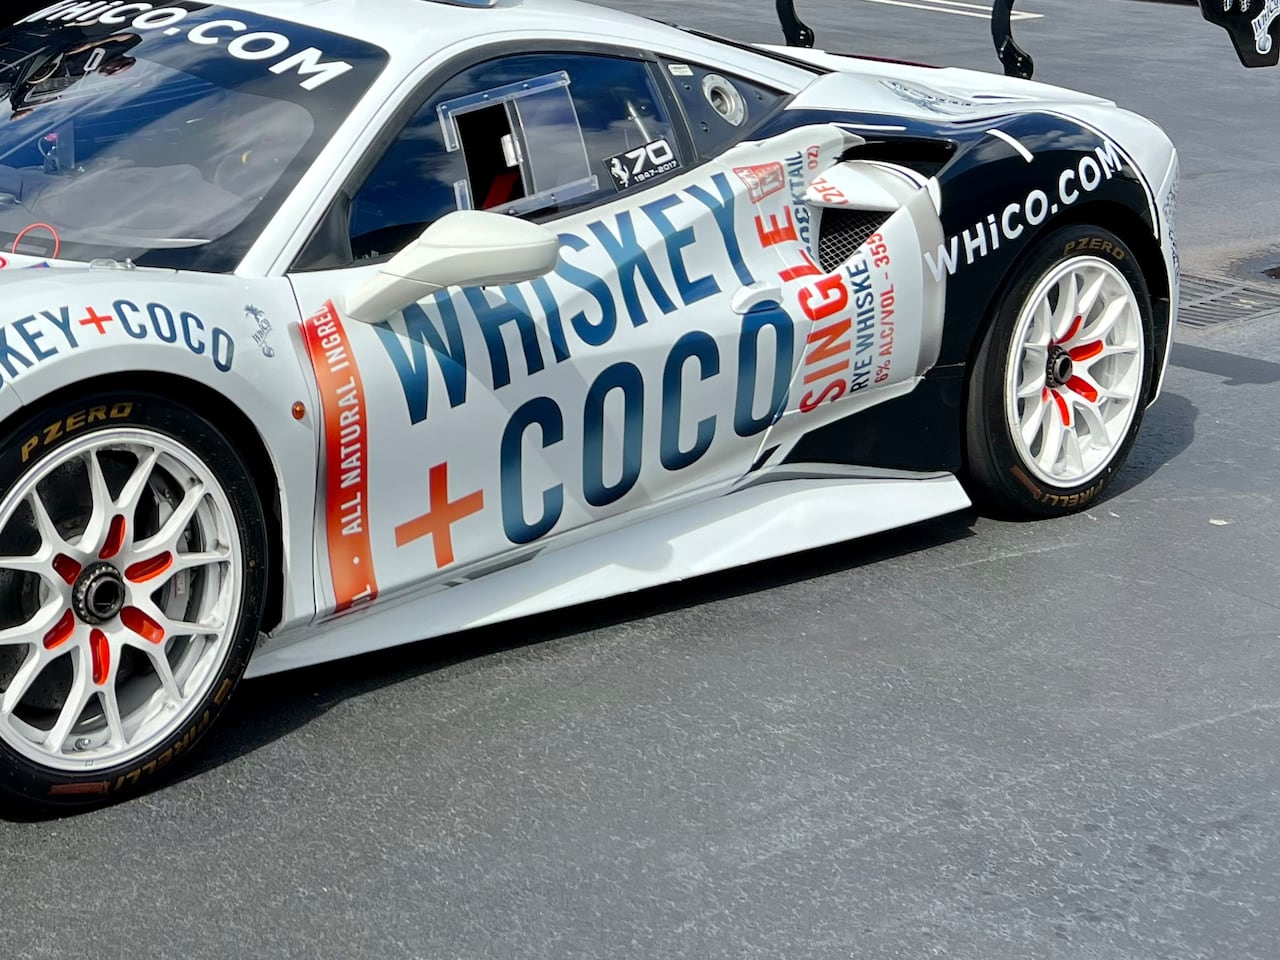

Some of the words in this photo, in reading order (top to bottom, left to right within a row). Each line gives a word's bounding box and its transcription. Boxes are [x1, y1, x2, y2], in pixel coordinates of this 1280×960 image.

[625, 140, 674, 174] 70
[634, 161, 677, 182] 1947-2017
[807, 145, 820, 170] OZ)
[754, 205, 853, 413] SINGLE
[879, 283, 895, 358] ALC/VOL
[848, 354, 874, 395] RYE
[874, 359, 893, 384] 6%
[337, 375, 363, 490] NATURAL
[341, 491, 363, 537] ALL
